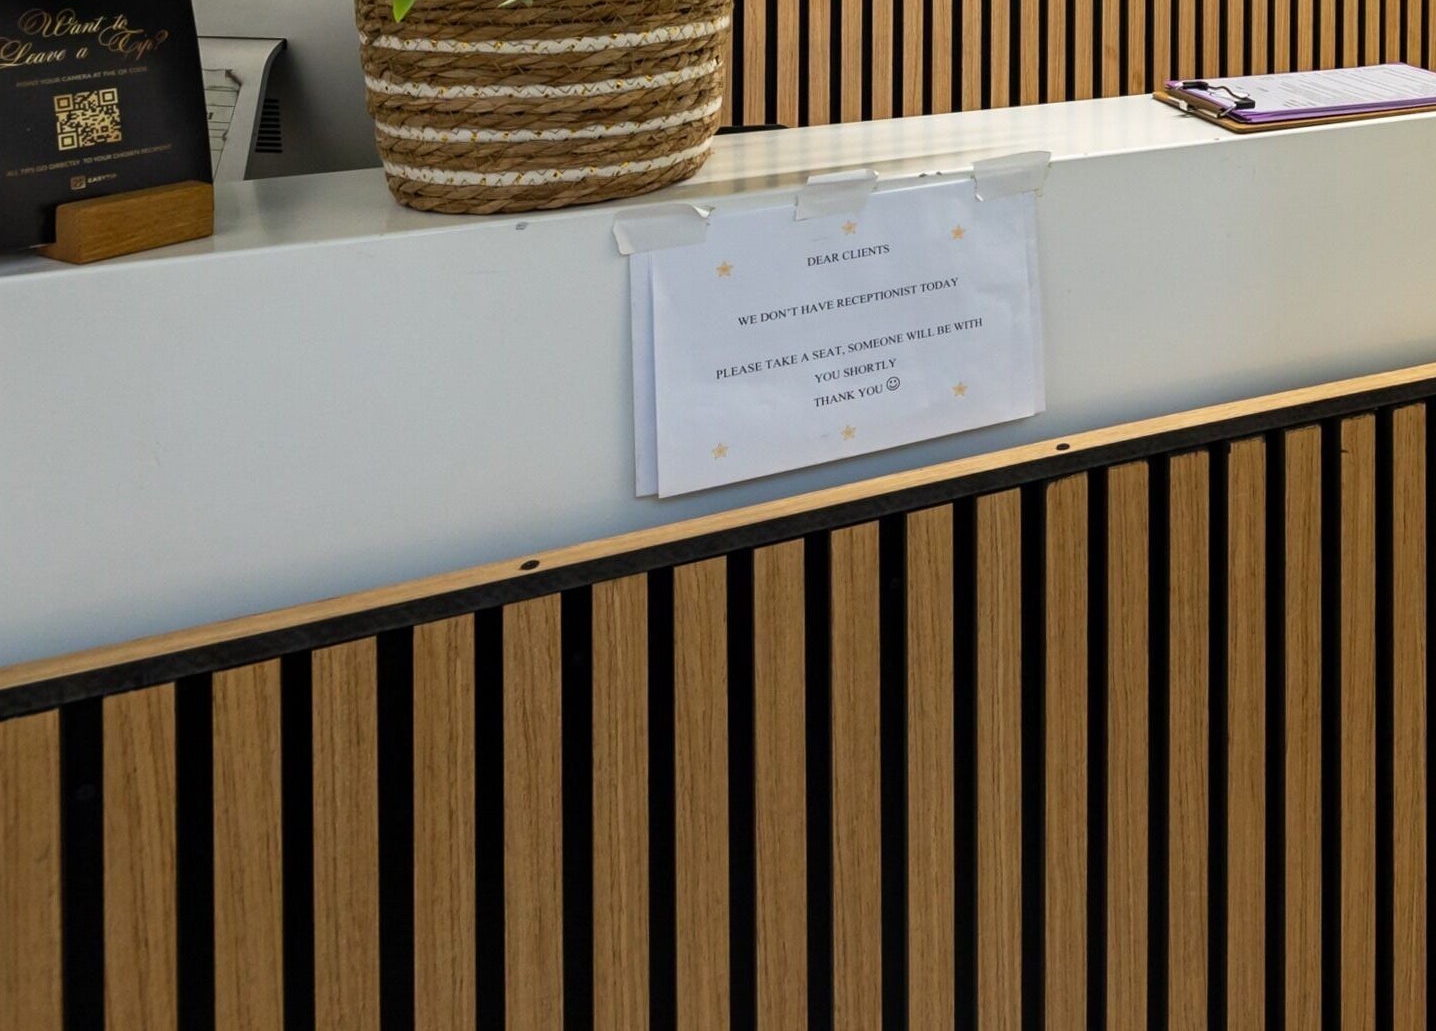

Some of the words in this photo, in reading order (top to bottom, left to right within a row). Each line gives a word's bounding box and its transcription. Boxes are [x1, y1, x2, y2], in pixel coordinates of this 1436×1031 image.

[19, 8, 105, 38] Want
[112, 14, 128, 30] to
[0, 36, 67, 69] Leave
[76, 47, 89, 59] a
[98, 26, 169, 60] Tip?
[41, 77, 60, 85] YOUR
[61, 73, 92, 82] CAMERA
[49, 160, 81, 170] DIRECTLY
[94, 154, 112, 162] YOUR
[113, 149, 140, 159] CHOSEN
[806, 252, 840, 267] DEAR
[842, 244, 890, 261] CLIENTS
[738, 314, 758, 326] WE
[801, 300, 834, 315] HAVE
[836, 285, 917, 308] RECEPTIONIST
[919, 277, 959, 293] TODAY
[716, 362, 762, 379] PLEASE
[765, 354, 798, 370] TAKE
[801, 353, 810, 362] A
[812, 346, 845, 360] SEAT,
[848, 333, 904, 353] SOMEONE
[906, 327, 935, 341] WILL
[937, 323, 952, 336] BE
[954, 317, 983, 332] WITH
[815, 370, 841, 384] YOU
[843, 358, 897, 378] SHORTLY
[814, 391, 855, 408] THANK
[858, 384, 883, 398] YOU
